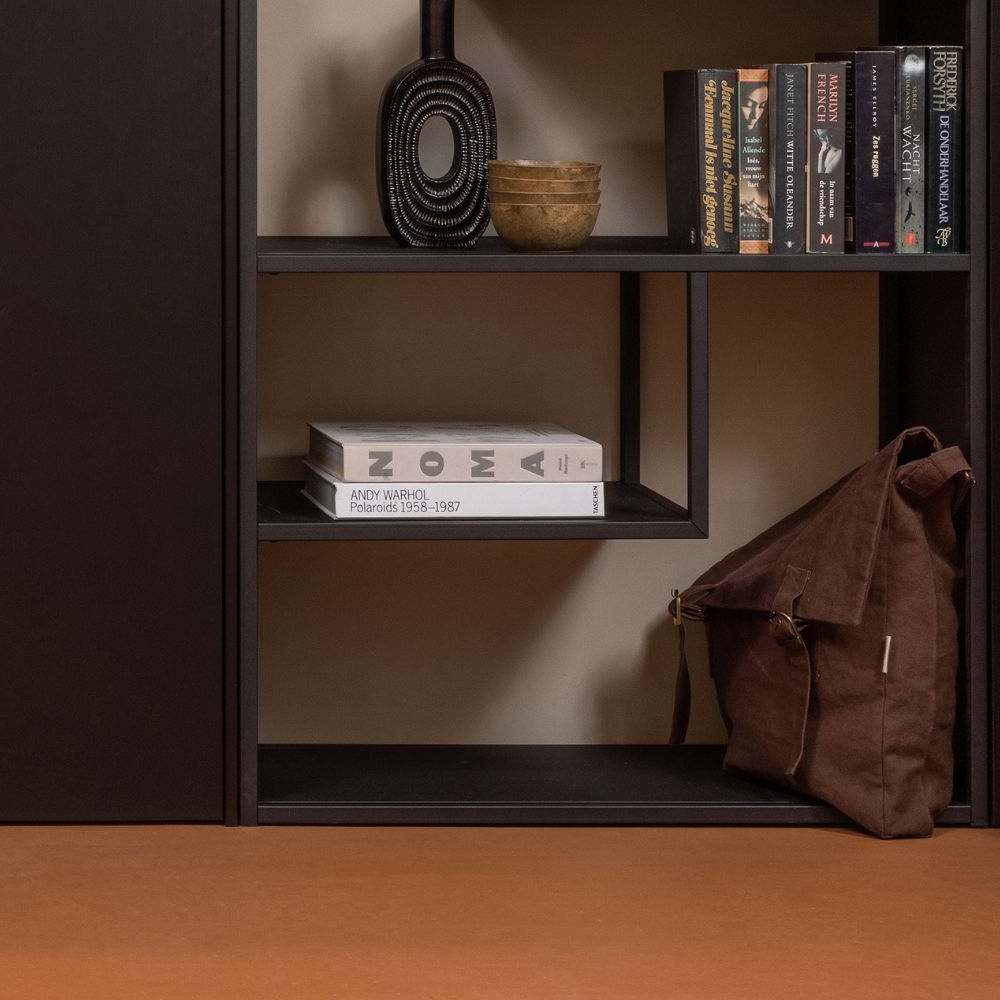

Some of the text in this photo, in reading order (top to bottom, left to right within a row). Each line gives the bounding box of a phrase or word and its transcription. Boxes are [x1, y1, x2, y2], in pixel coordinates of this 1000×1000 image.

[817, 74, 827, 122] FRENCH
[828, 74, 839, 122] MARILYN
[932, 51, 946, 112] FORSYTH
[946, 51, 958, 112] FREDERICK
[744, 136, 762, 144] Isabel
[939, 115, 950, 130] DE
[702, 79, 719, 249] Eenmaal is niet genoeg
[720, 79, 737, 233] Jacqueline Susann
[742, 146, 765, 154] Allende
[785, 73, 794, 229] JANET FITCH WITTE OLEANDER
[871, 135, 881, 178] Zes ruggen
[901, 125, 912, 184] WACHT
[912, 134, 921, 176] NACHT
[939, 130, 950, 224] ONDERHANDELAAR
[817, 180, 826, 226] de vriendschap
[820, 234, 833, 244] M
[350, 489, 430, 501] ANDY WARHOL
[350, 501, 398, 513] Polaroids
